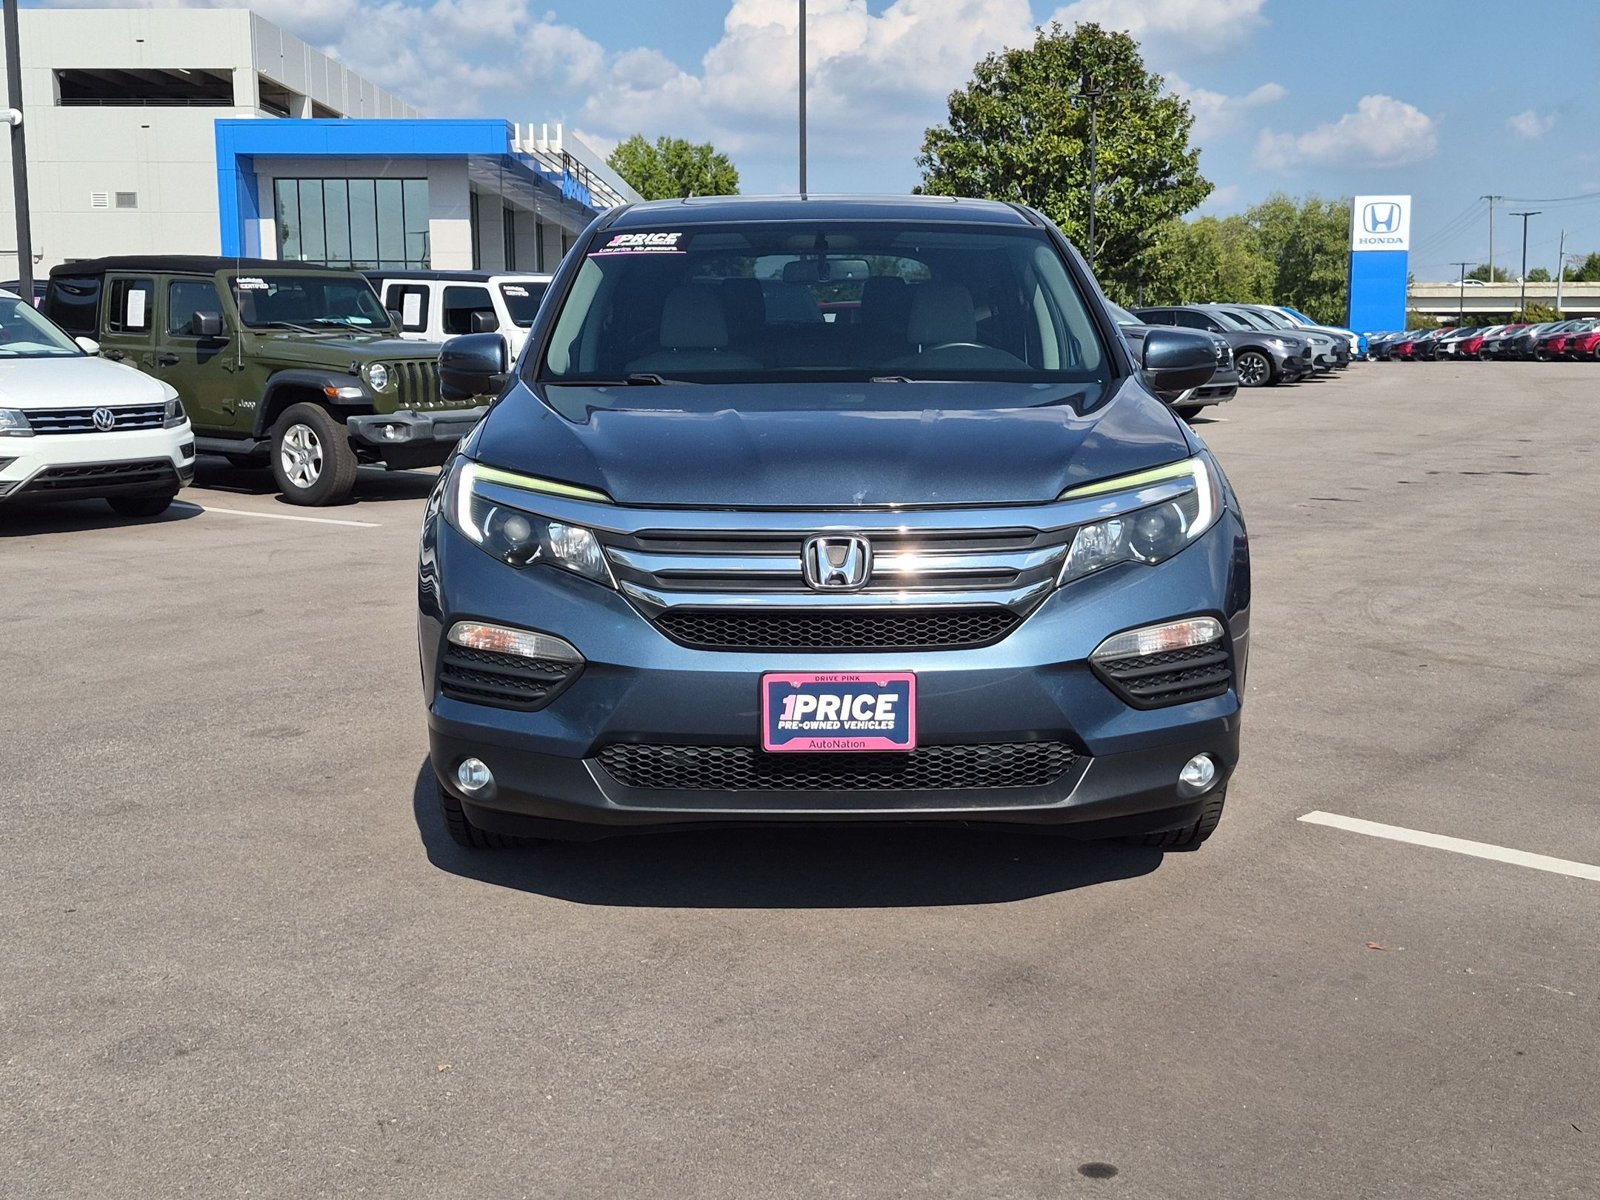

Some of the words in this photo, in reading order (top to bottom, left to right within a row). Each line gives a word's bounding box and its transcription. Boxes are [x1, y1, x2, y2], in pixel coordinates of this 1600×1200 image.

[611, 233, 682, 245] 1PRICE
[238, 399, 256, 411] Jeep
[780, 693, 899, 721] 1PRICE
[778, 720, 841, 730] PRE-OWNED
[844, 720, 895, 729] VEHICLES
[808, 739, 866, 749] AutoNation
